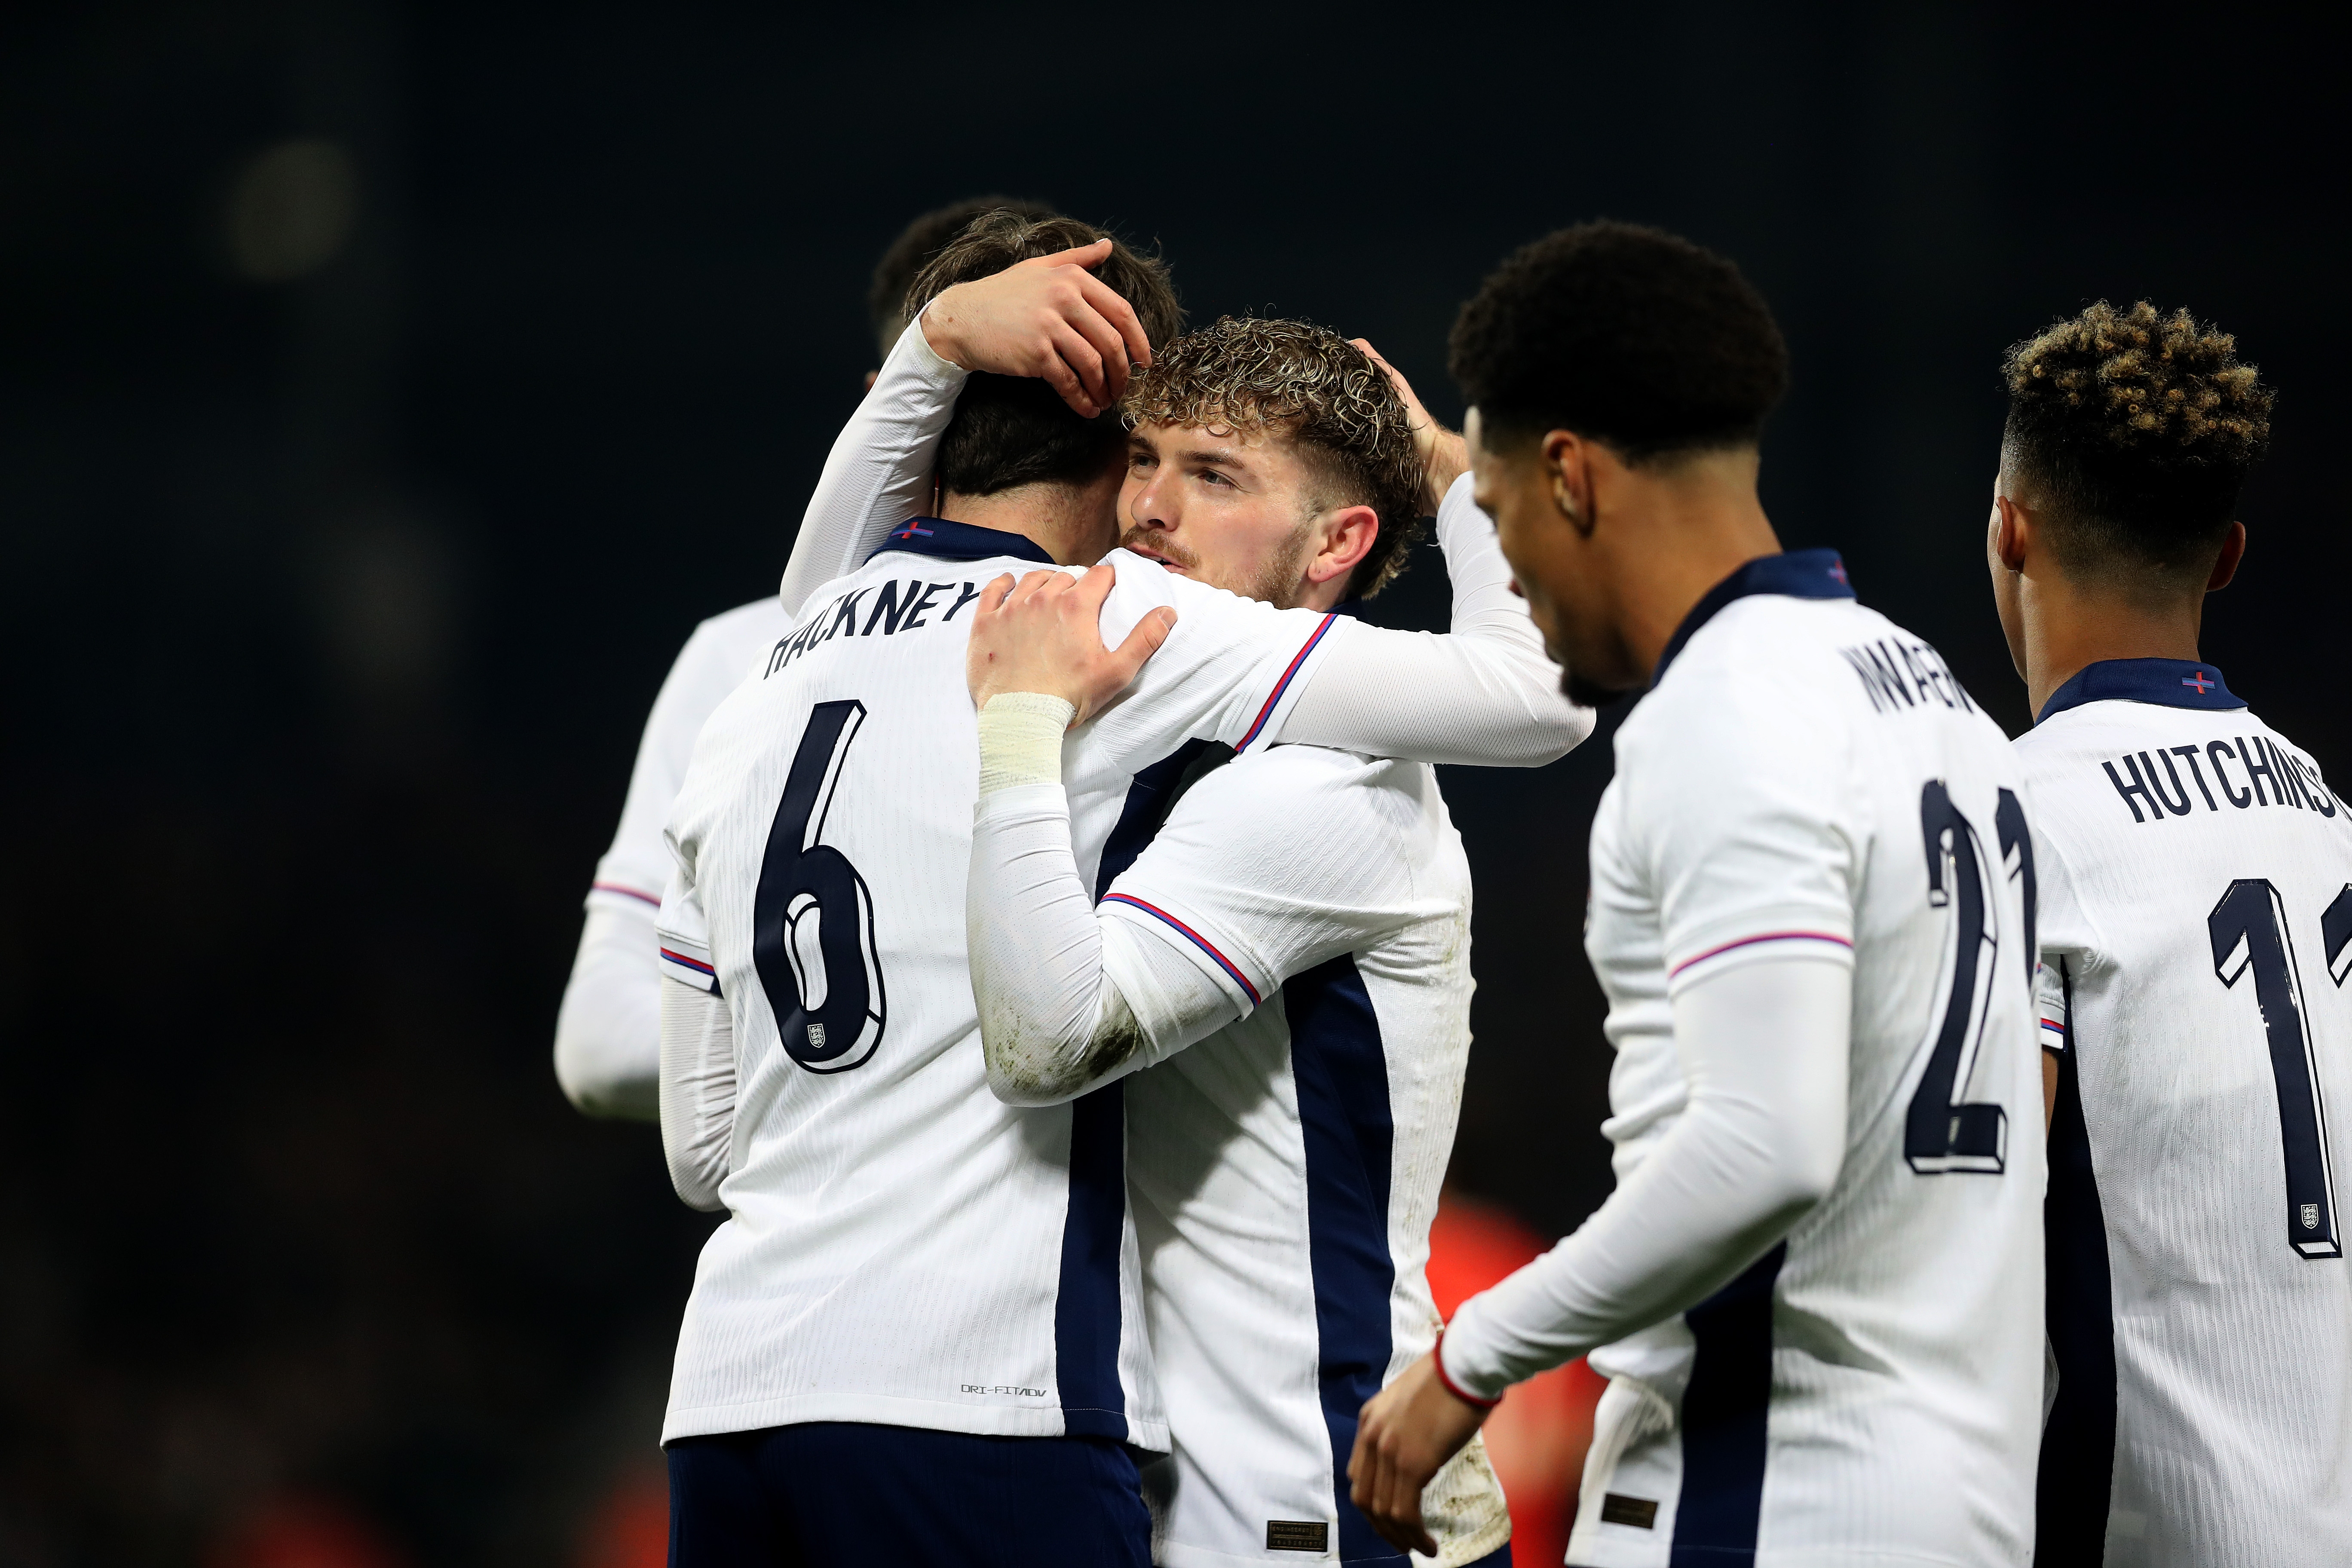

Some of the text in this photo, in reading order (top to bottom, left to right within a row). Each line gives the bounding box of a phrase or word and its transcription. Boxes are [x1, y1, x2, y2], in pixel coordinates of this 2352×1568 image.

[763, 579, 981, 680] HACKNEY
[2101, 736, 2352, 823] HUTCHINS
[753, 698, 887, 1075] 6
